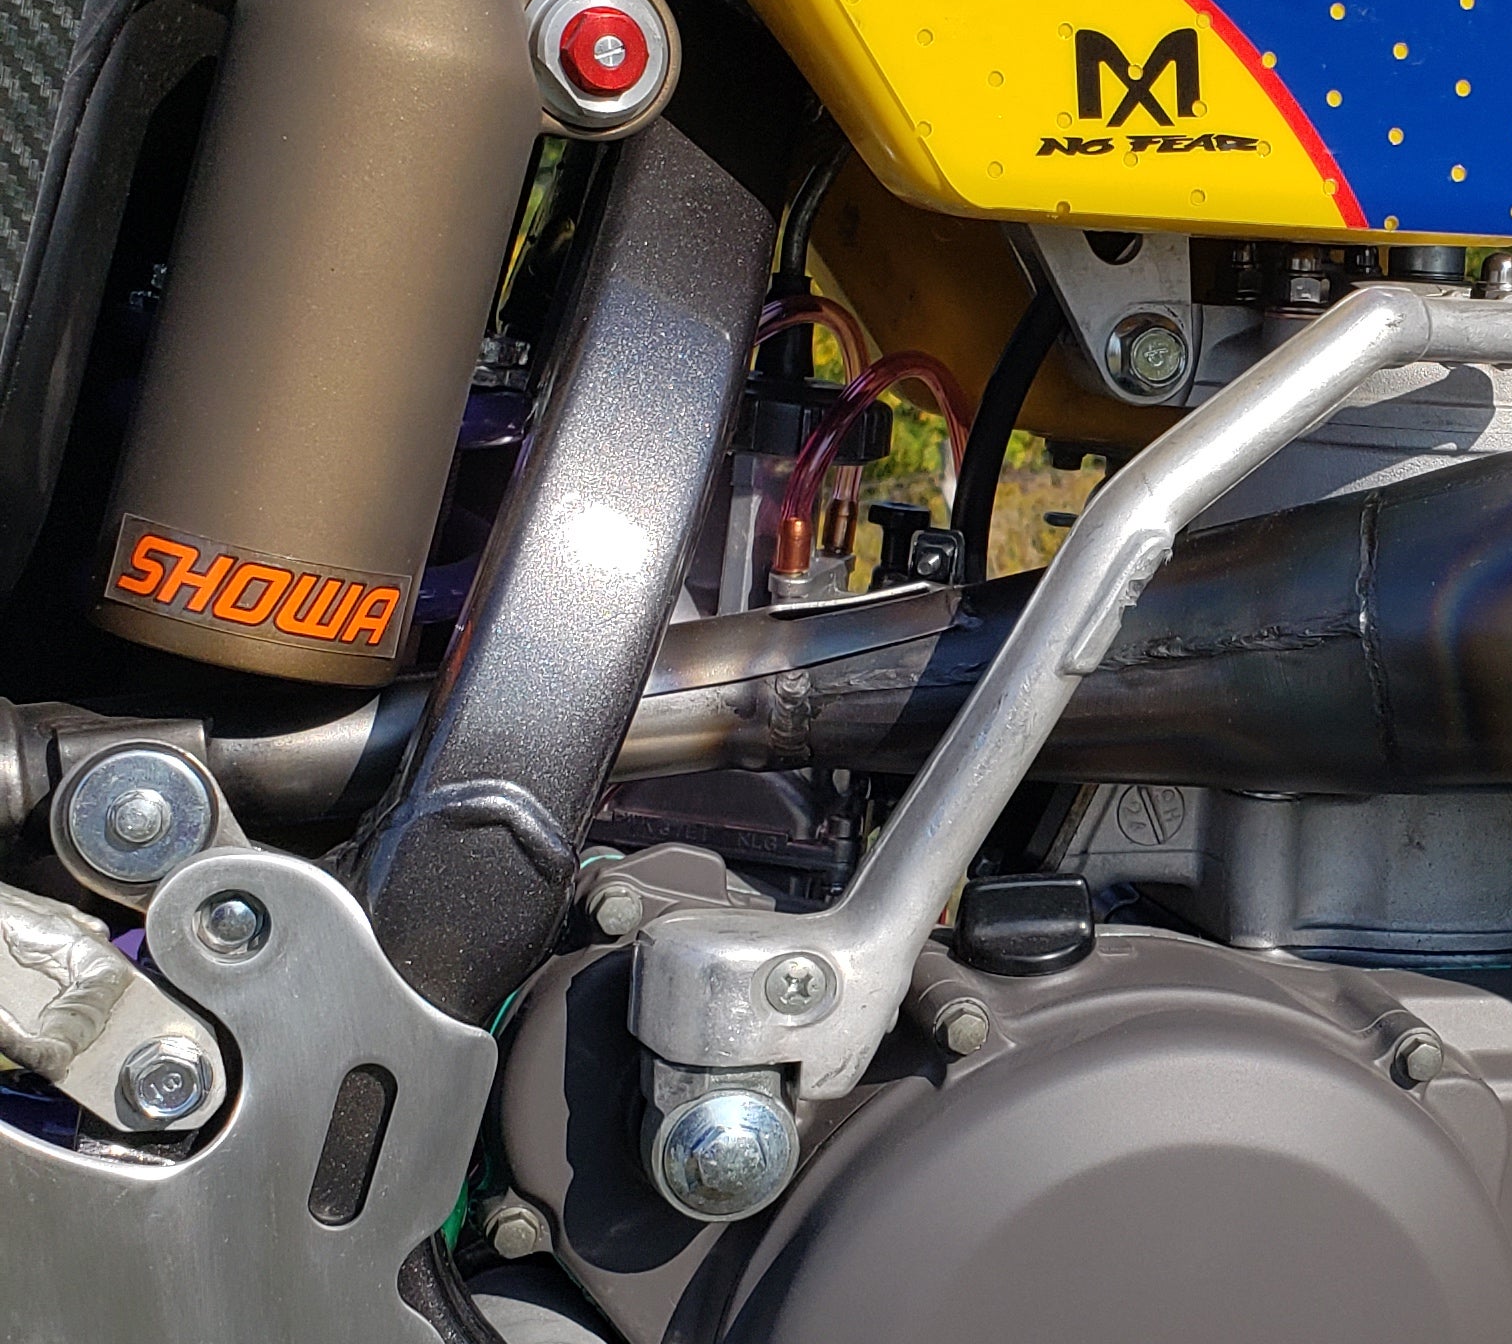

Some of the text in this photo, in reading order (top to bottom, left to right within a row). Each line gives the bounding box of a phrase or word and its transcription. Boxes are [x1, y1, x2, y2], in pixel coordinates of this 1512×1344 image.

[1035, 133, 1260, 156] NO FEAR
[116, 533, 401, 646] SHOWA
